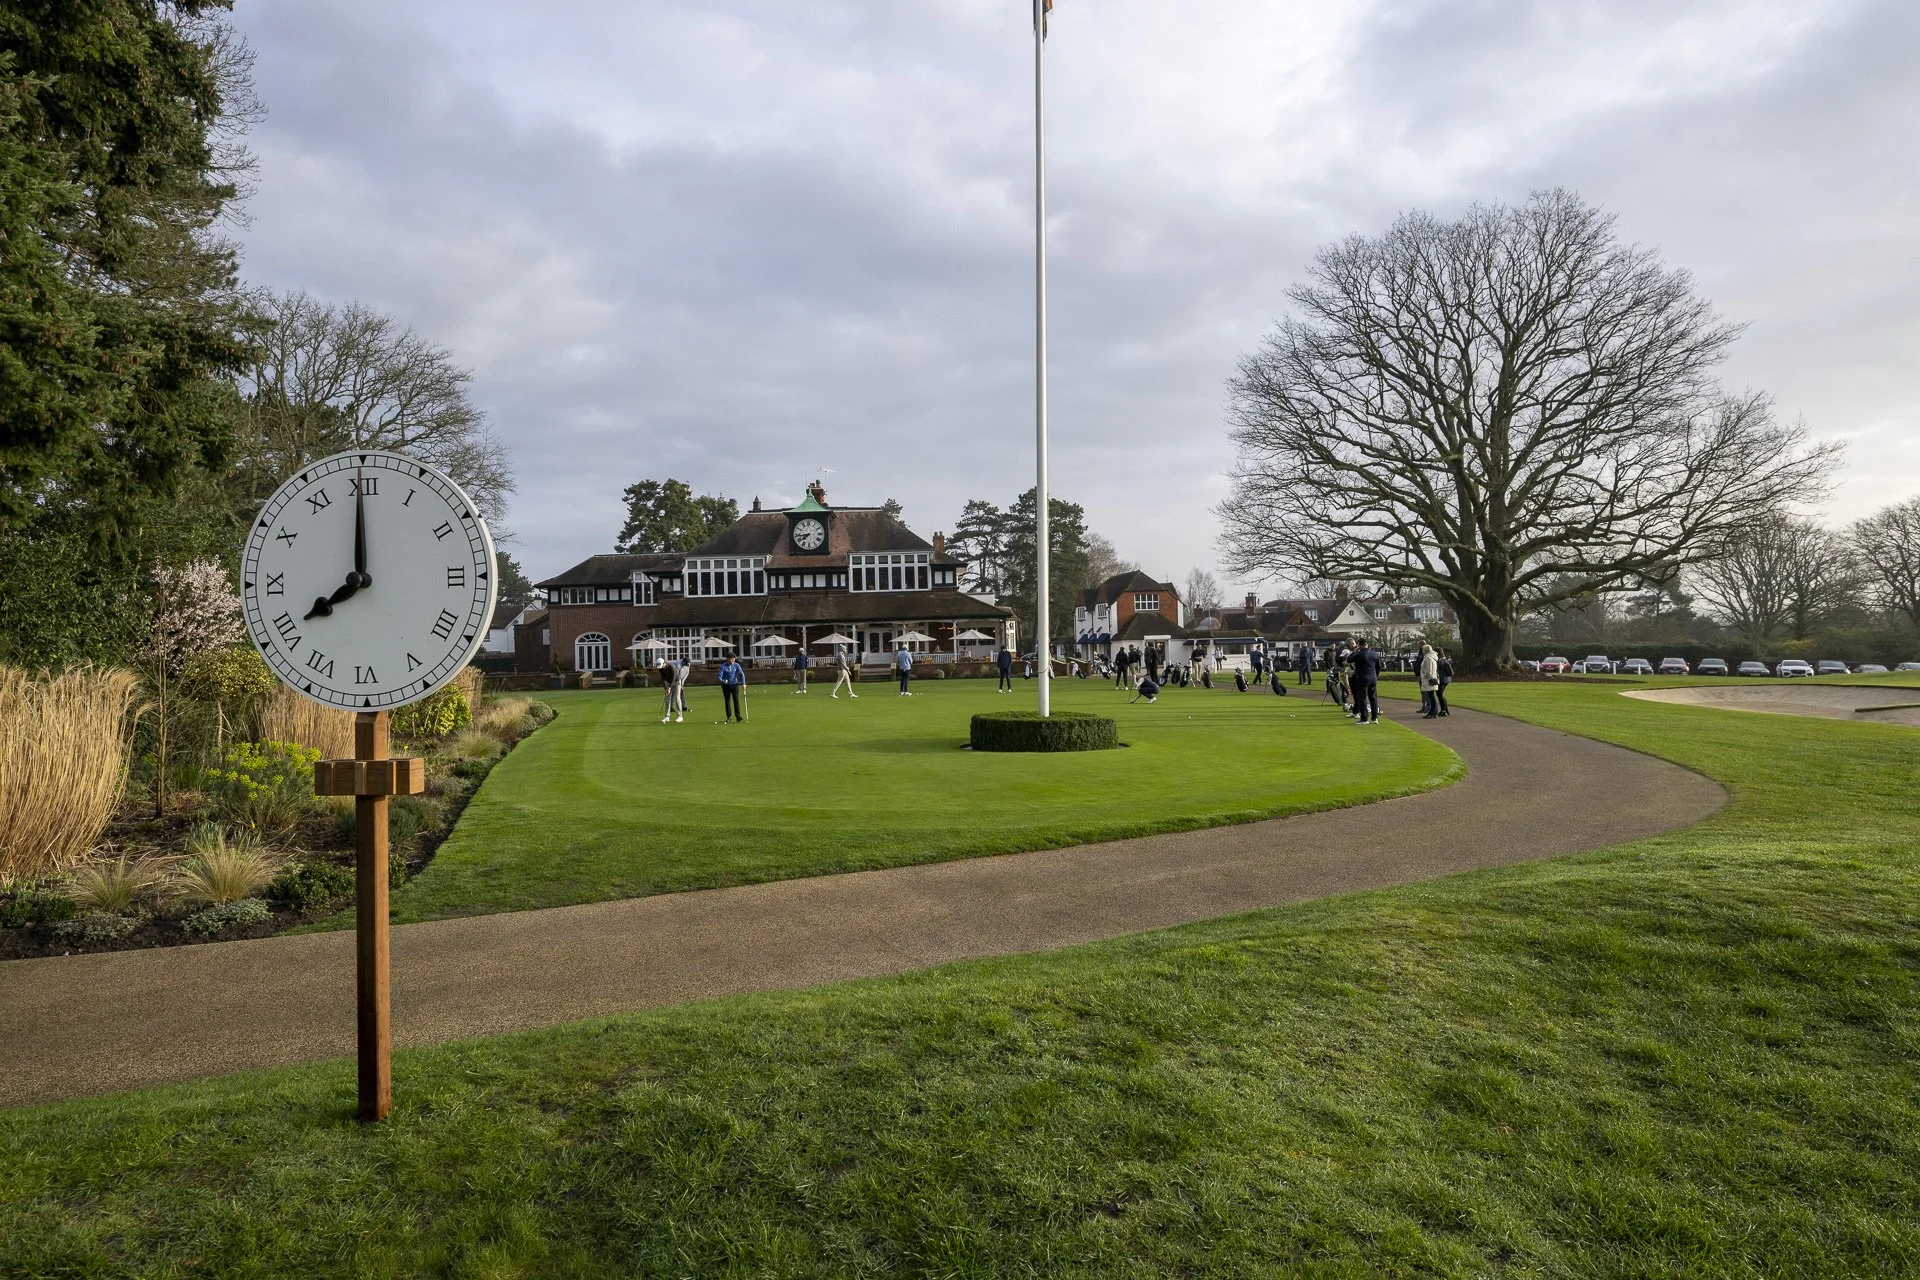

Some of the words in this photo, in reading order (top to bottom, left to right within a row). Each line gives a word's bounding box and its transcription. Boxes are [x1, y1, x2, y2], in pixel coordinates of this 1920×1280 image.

[305, 488, 332, 515] XI
[402, 489, 416, 507] I
[276, 526, 298, 548] X
[433, 520, 453, 541] II
[267, 572, 284, 596] IX
[447, 565, 464, 588] III
[272, 611, 302, 652] VIII
[431, 608, 459, 641] IIII
[305, 650, 334, 679] VII
[406, 652, 423, 672] V
[354, 666, 379, 684] VI
